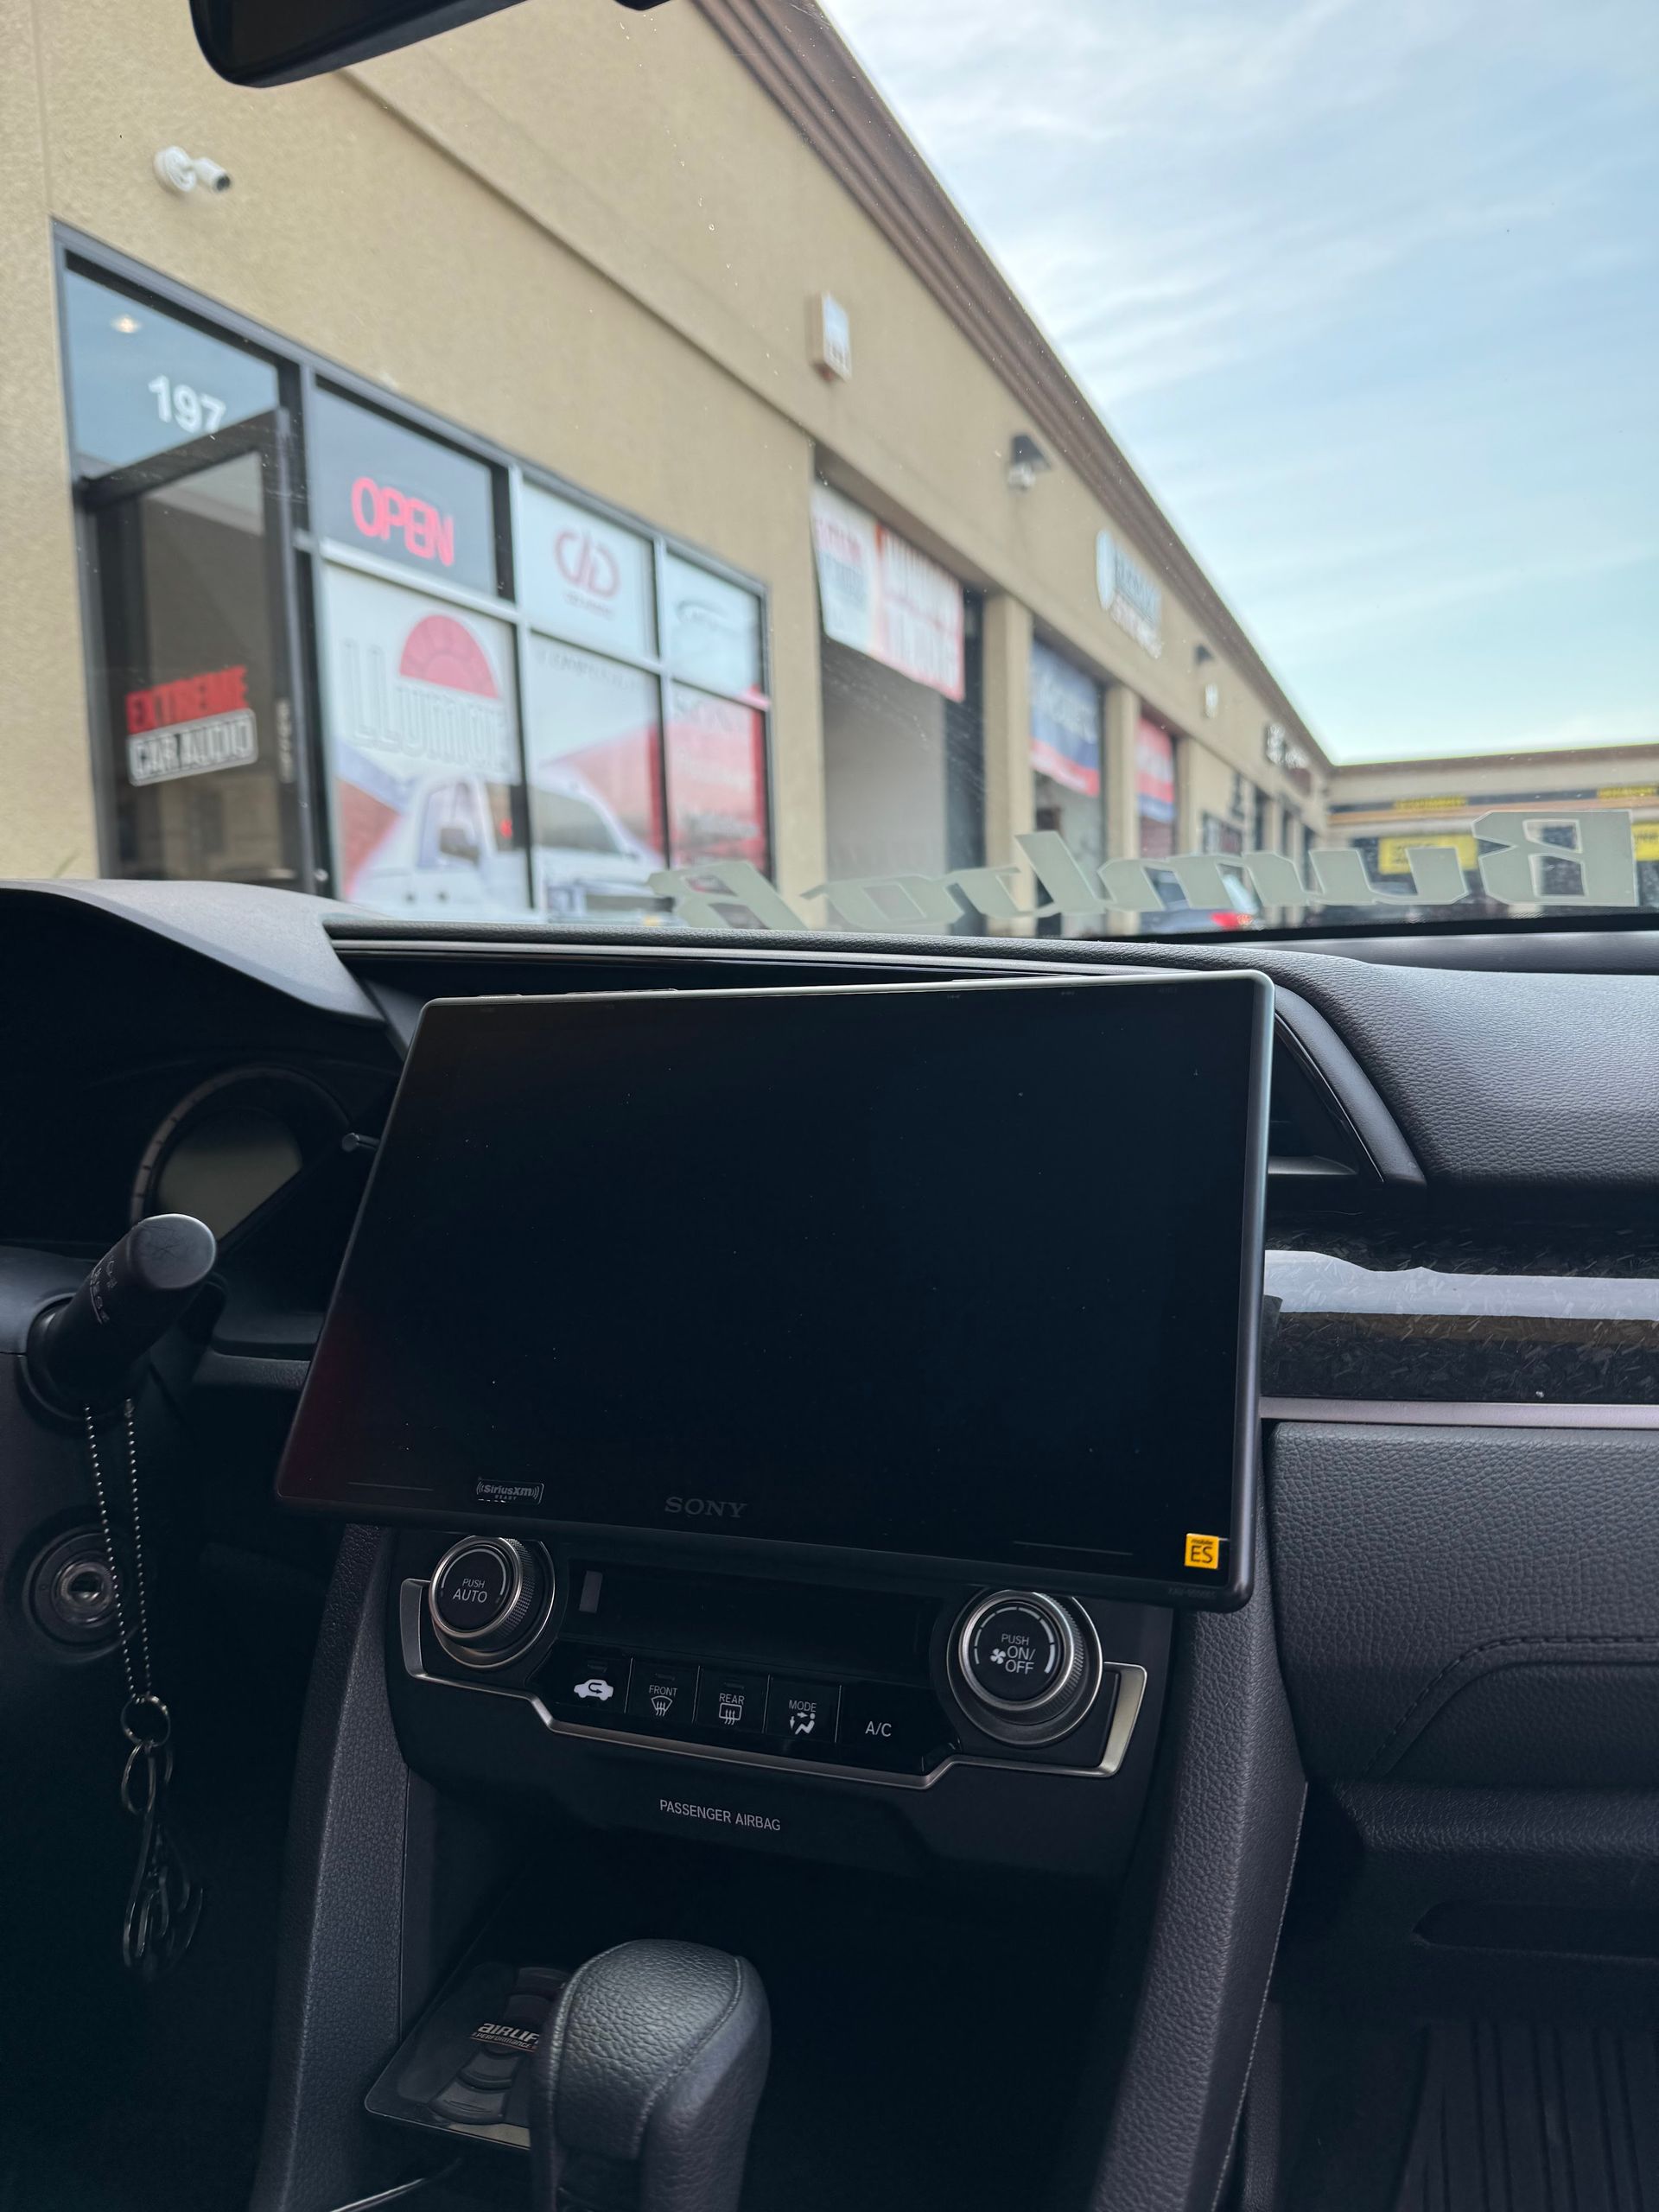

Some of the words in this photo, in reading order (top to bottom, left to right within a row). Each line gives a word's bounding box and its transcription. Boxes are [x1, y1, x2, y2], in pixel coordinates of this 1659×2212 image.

[149, 374, 226, 434] 197
[352, 476, 454, 567] OPEN
[130, 733, 179, 779] CAR
[181, 716, 253, 767] AUDIO
[664, 1496, 748, 1518] SONY
[1191, 1545, 1213, 1564] ES
[461, 1578, 486, 1589] PUSH
[452, 1588, 488, 1604] AUTO
[1001, 1633, 1030, 1645] PUSH
[1005, 1659, 1035, 1675] OFF
[648, 1684, 678, 1698] FRONT
[719, 1693, 745, 1705] REAR
[788, 1700, 817, 1713] MODE
[865, 1720, 893, 1738] A/C
[659, 1799, 732, 1823] PASSENGER
[734, 1813, 781, 1832] AIRBAG
